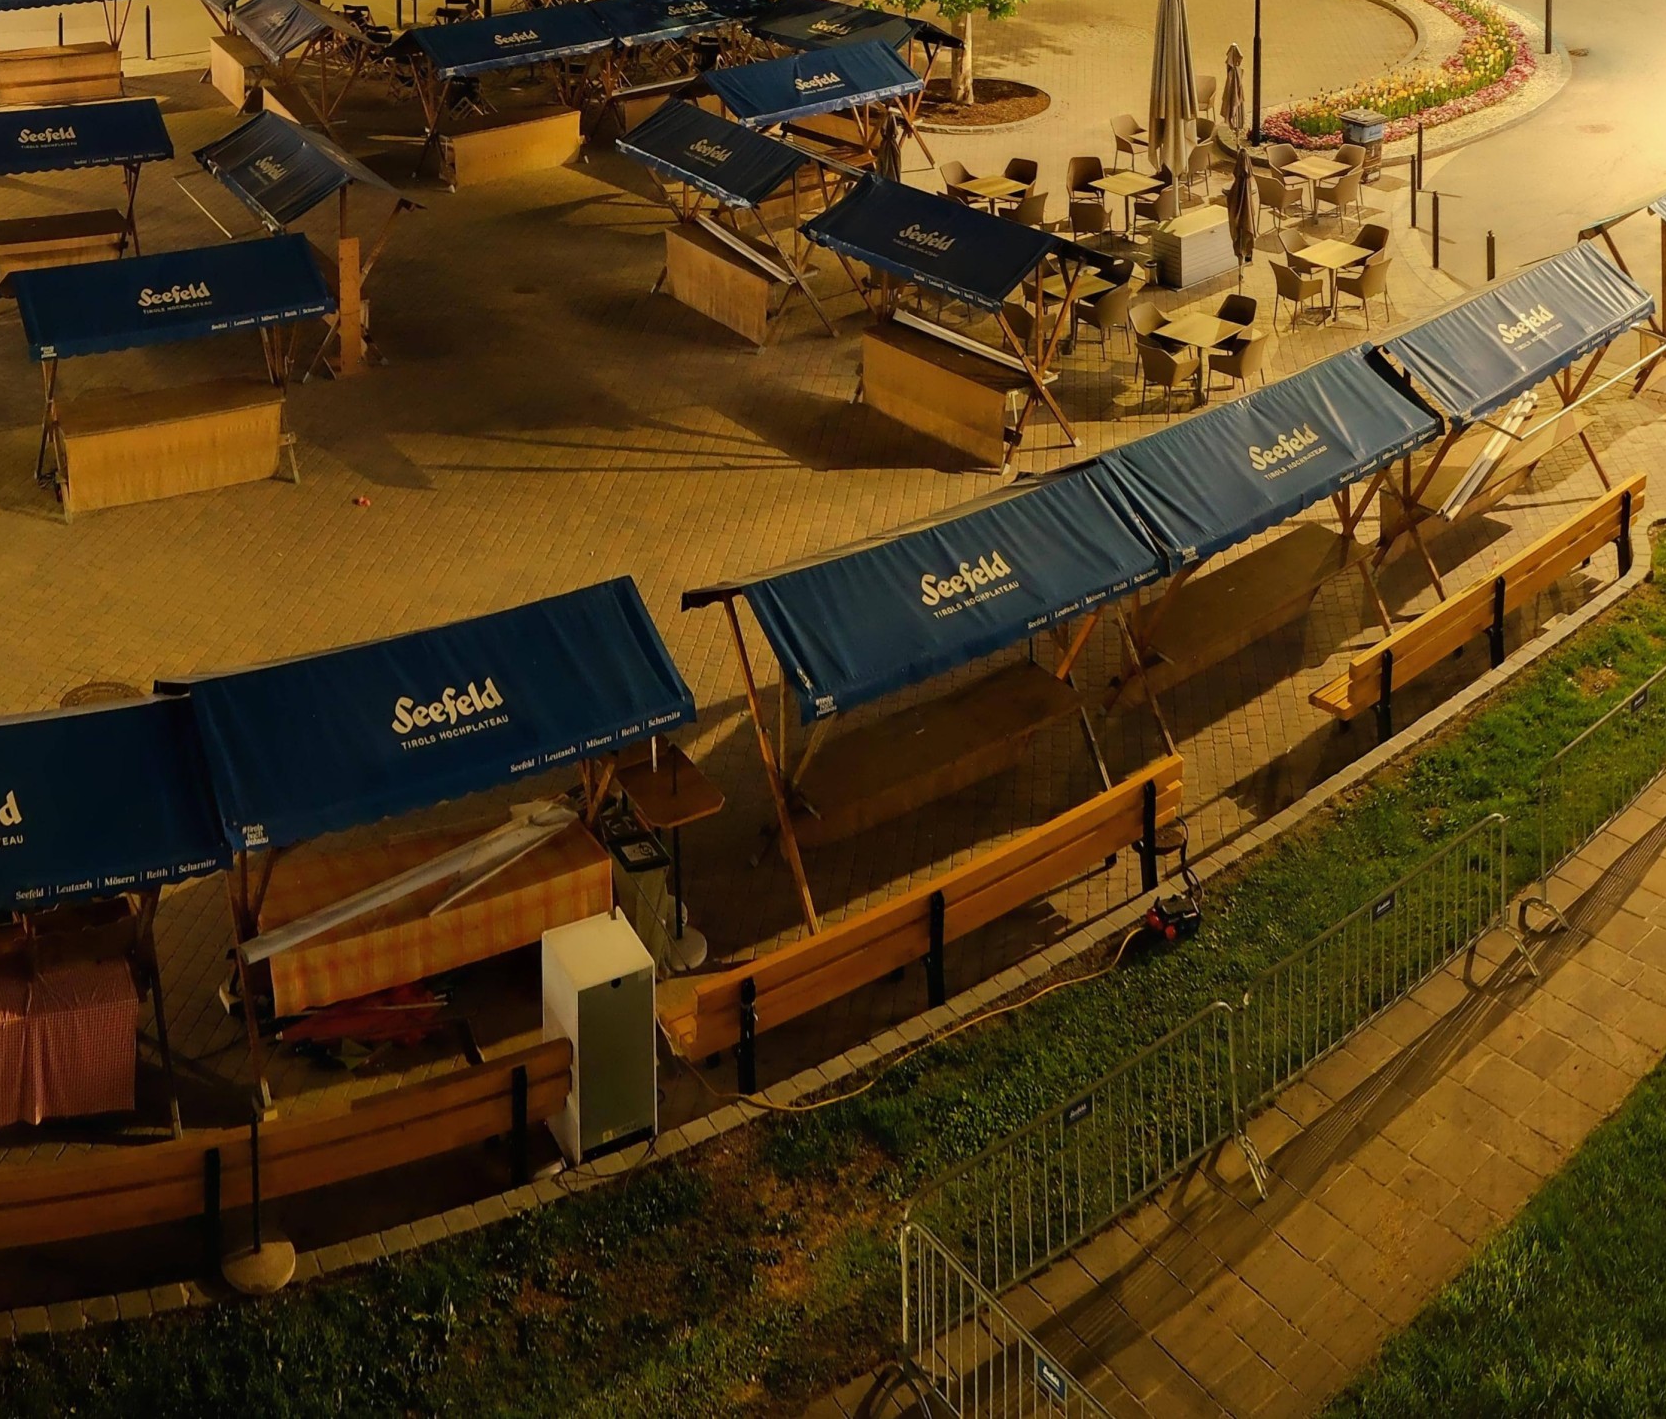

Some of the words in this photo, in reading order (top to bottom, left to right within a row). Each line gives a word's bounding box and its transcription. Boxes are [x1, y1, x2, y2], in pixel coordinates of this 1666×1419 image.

[667, 0, 709, 16] Seefeld
[494, 29, 539, 45] Seefeld
[795, 72, 841, 91] Seefeld
[17, 126, 76, 144] Seefeld
[689, 138, 733, 163] Seefeld
[900, 223, 957, 252] Seefeld
[137, 281, 211, 307] Seefeld
[1498, 304, 1554, 345] Seefeld
[1248, 422, 1319, 471] Seefeld
[920, 550, 1012, 607] Seefeld
[934, 602, 963, 620] TIROLS
[963, 580, 1020, 609] HOCHPLATEAU
[391, 676, 504, 736] Seefeld
[401, 734, 437, 751] TIROLS
[439, 713, 509, 742] HOCHPLATEAU
[509, 759, 535, 773] Seefeld
[544, 745, 576, 763] Leutasch
[621, 724, 640, 738] Reith
[648, 710, 681, 729] Scharnitz
[16, 887, 44, 900] Seefeld
[56, 880, 93, 894] Leutasch
[104, 874, 135, 887] Mösern
[146, 868, 168, 880] Reith
[178, 858, 217, 874] Scharnitz
